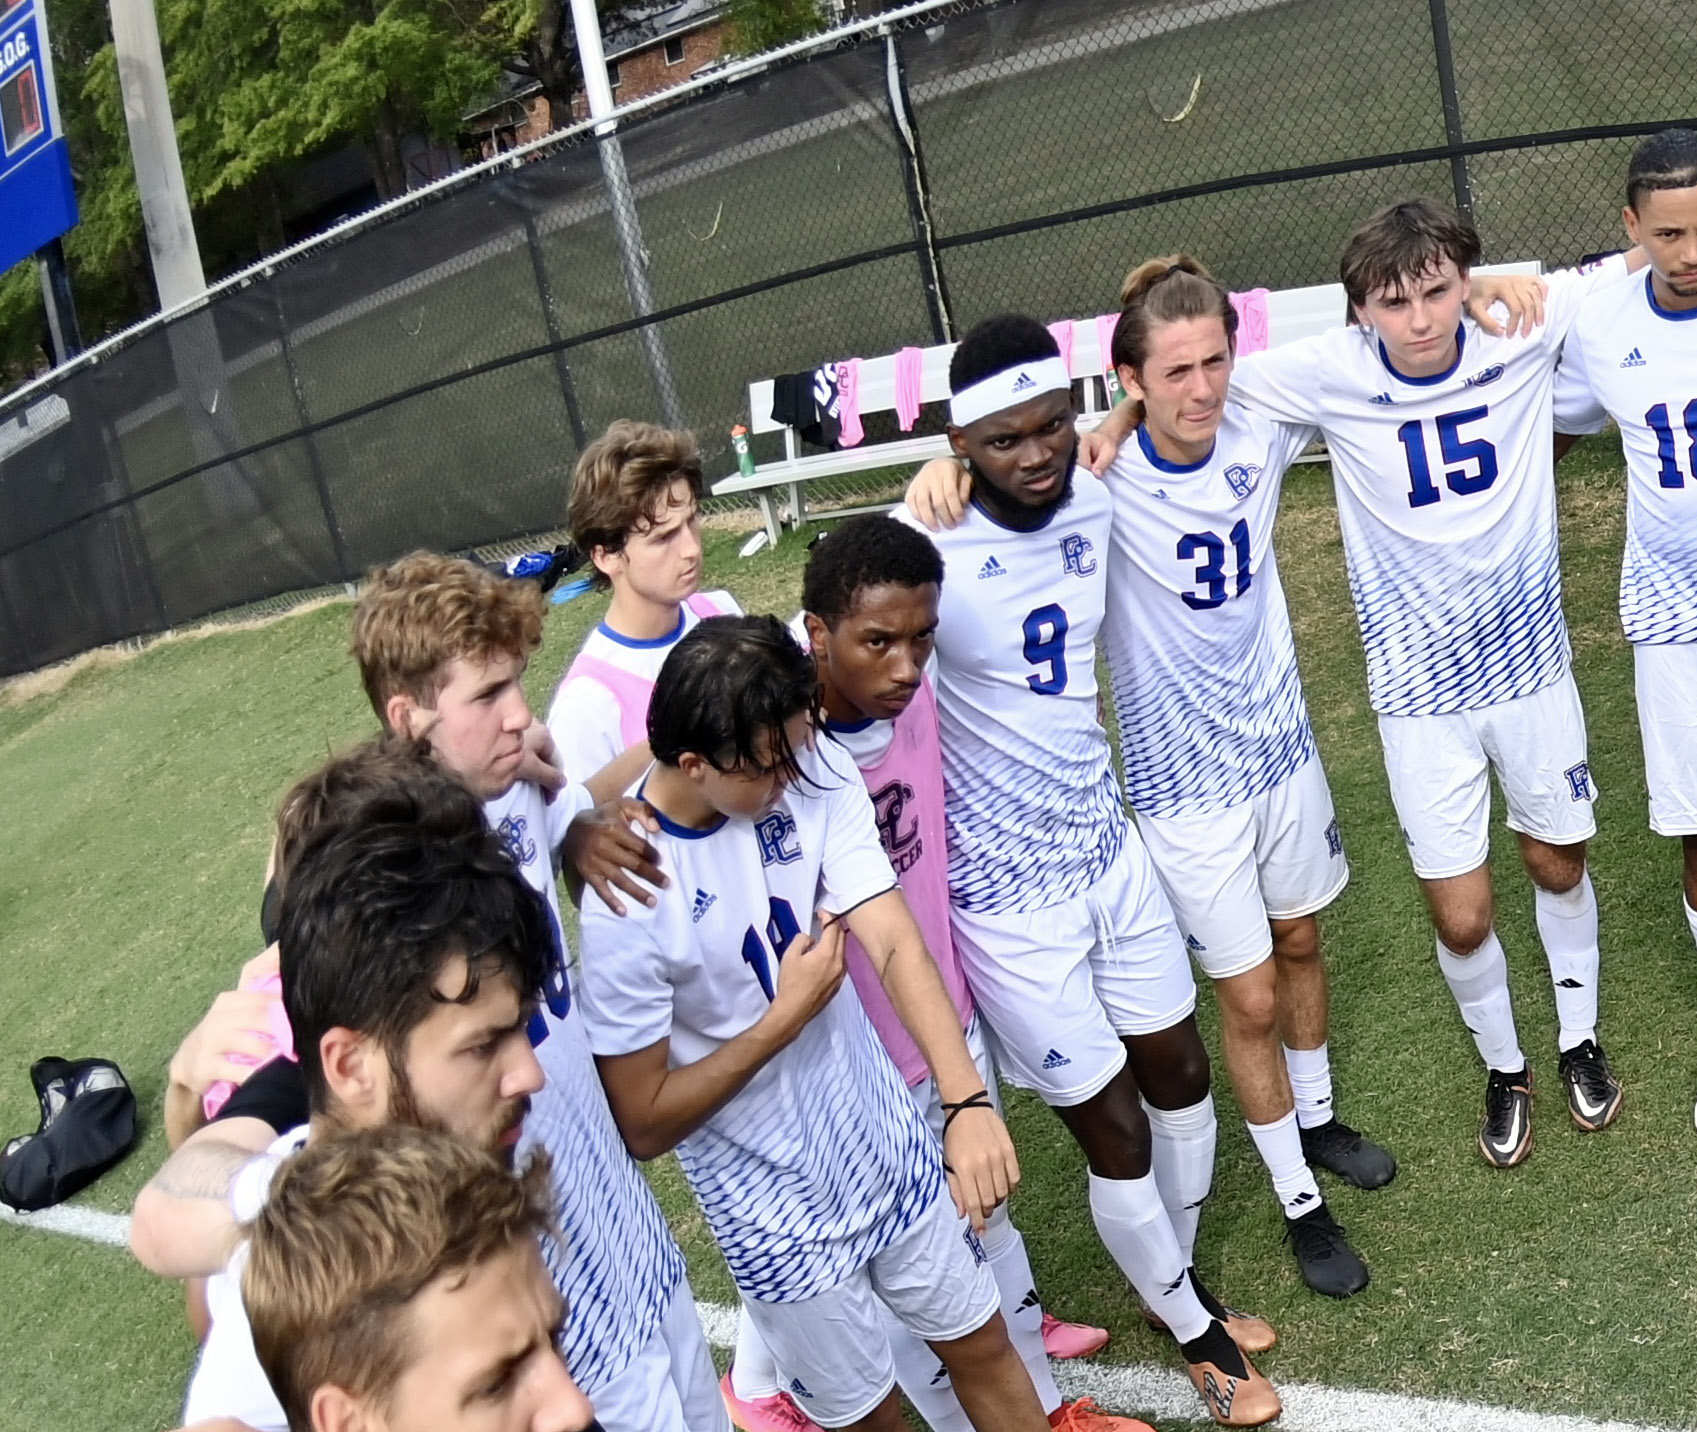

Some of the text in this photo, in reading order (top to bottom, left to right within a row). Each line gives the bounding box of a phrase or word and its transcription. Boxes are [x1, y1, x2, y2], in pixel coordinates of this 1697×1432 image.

[1397, 404, 1499, 509] 15
[1058, 531, 1098, 578] PC
[1176, 516, 1254, 611] 31
[1020, 602, 1070, 697] 9
